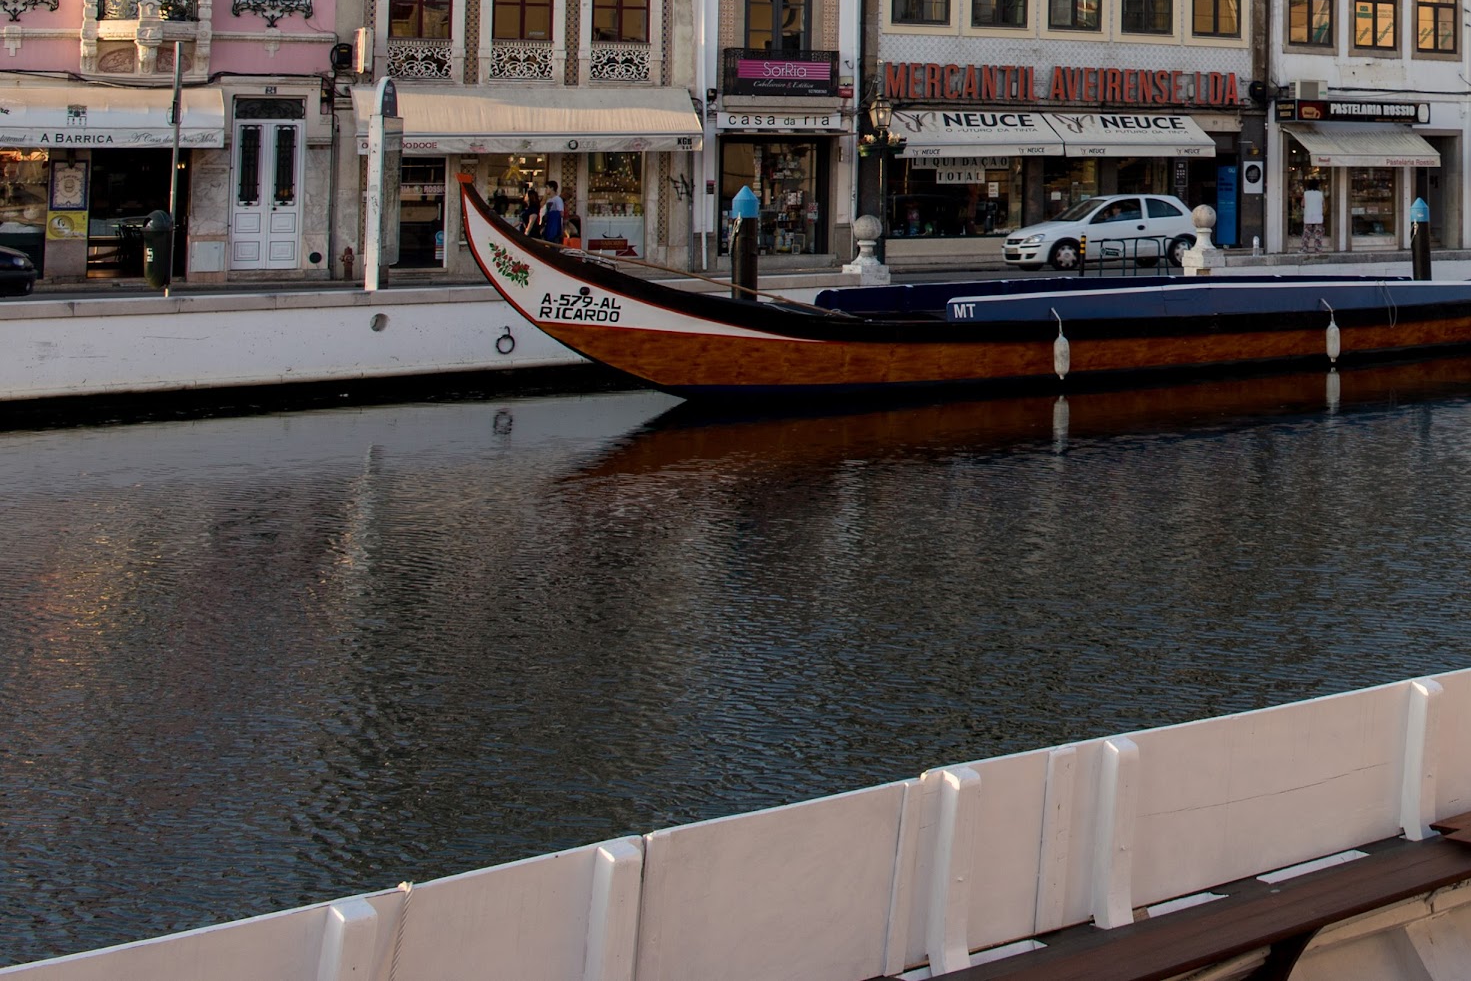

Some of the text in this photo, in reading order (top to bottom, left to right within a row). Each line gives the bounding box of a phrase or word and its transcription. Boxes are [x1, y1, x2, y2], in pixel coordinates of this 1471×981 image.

[762, 61, 807, 78] SorRia
[885, 62, 1040, 101] MERCANTIL
[1330, 103, 1415, 117] PASTELARIA ROSSIO
[728, 115, 830, 126] casa da ria
[942, 112, 1035, 128] NEUCE
[1102, 115, 1186, 130] NEUCE
[40, 133, 114, 144] A BARRICA
[1386, 158, 1435, 166] Pastelaria Rossio
[937, 171, 983, 181] TOTAL
[541, 293, 621, 310] A-579-AL
[539, 306, 620, 323] RICARDO
[953, 303, 976, 319] MT
